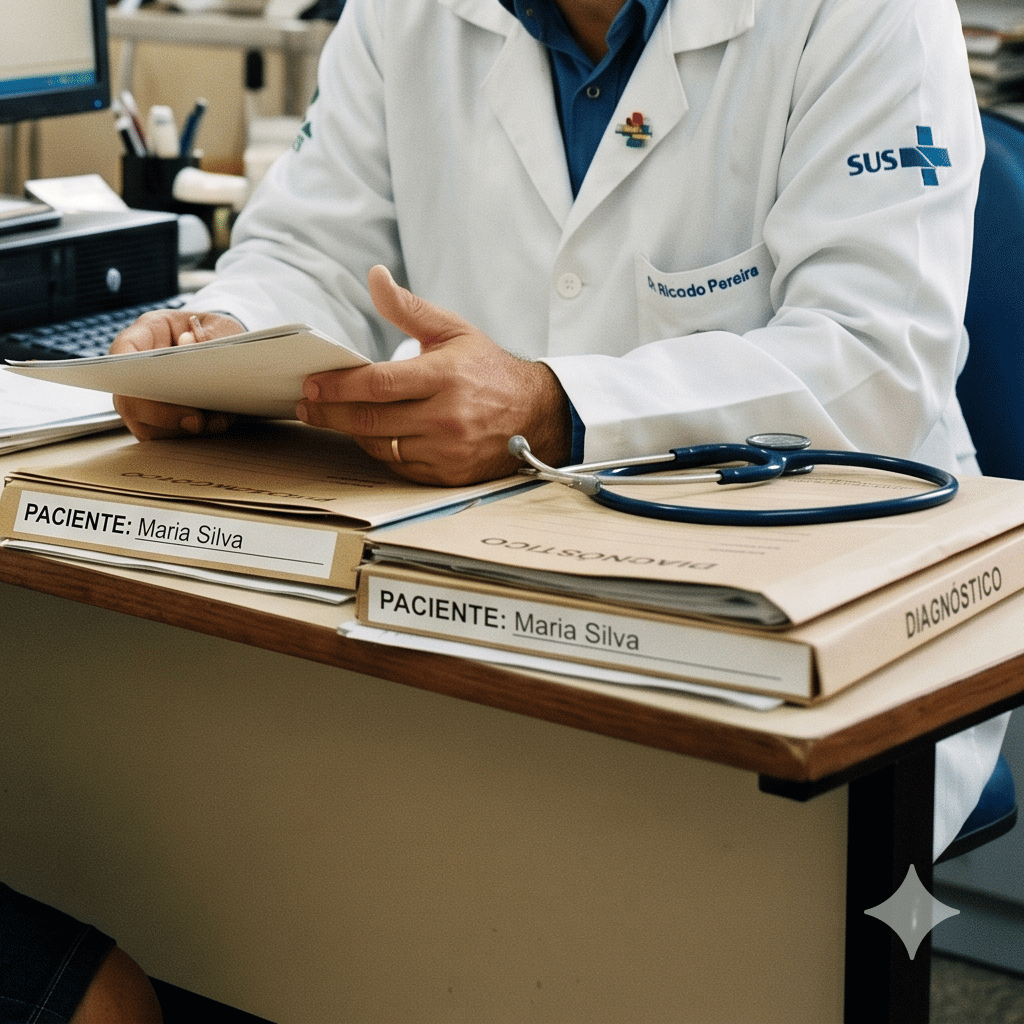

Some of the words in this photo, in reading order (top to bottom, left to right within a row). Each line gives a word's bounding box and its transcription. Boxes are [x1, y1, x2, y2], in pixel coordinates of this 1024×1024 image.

[847, 150, 898, 176] SUS
[707, 266, 759, 293] Pereira
[24, 503, 132, 536] PACIENTE:
[137, 517, 190, 542] Maria
[196, 524, 244, 549] Silva
[380, 590, 506, 630] PACIENTE:
[514, 611, 577, 640] Maria
[585, 622, 640, 651] Silva
[905, 566, 1002, 639] DIAGNÓSTICO
